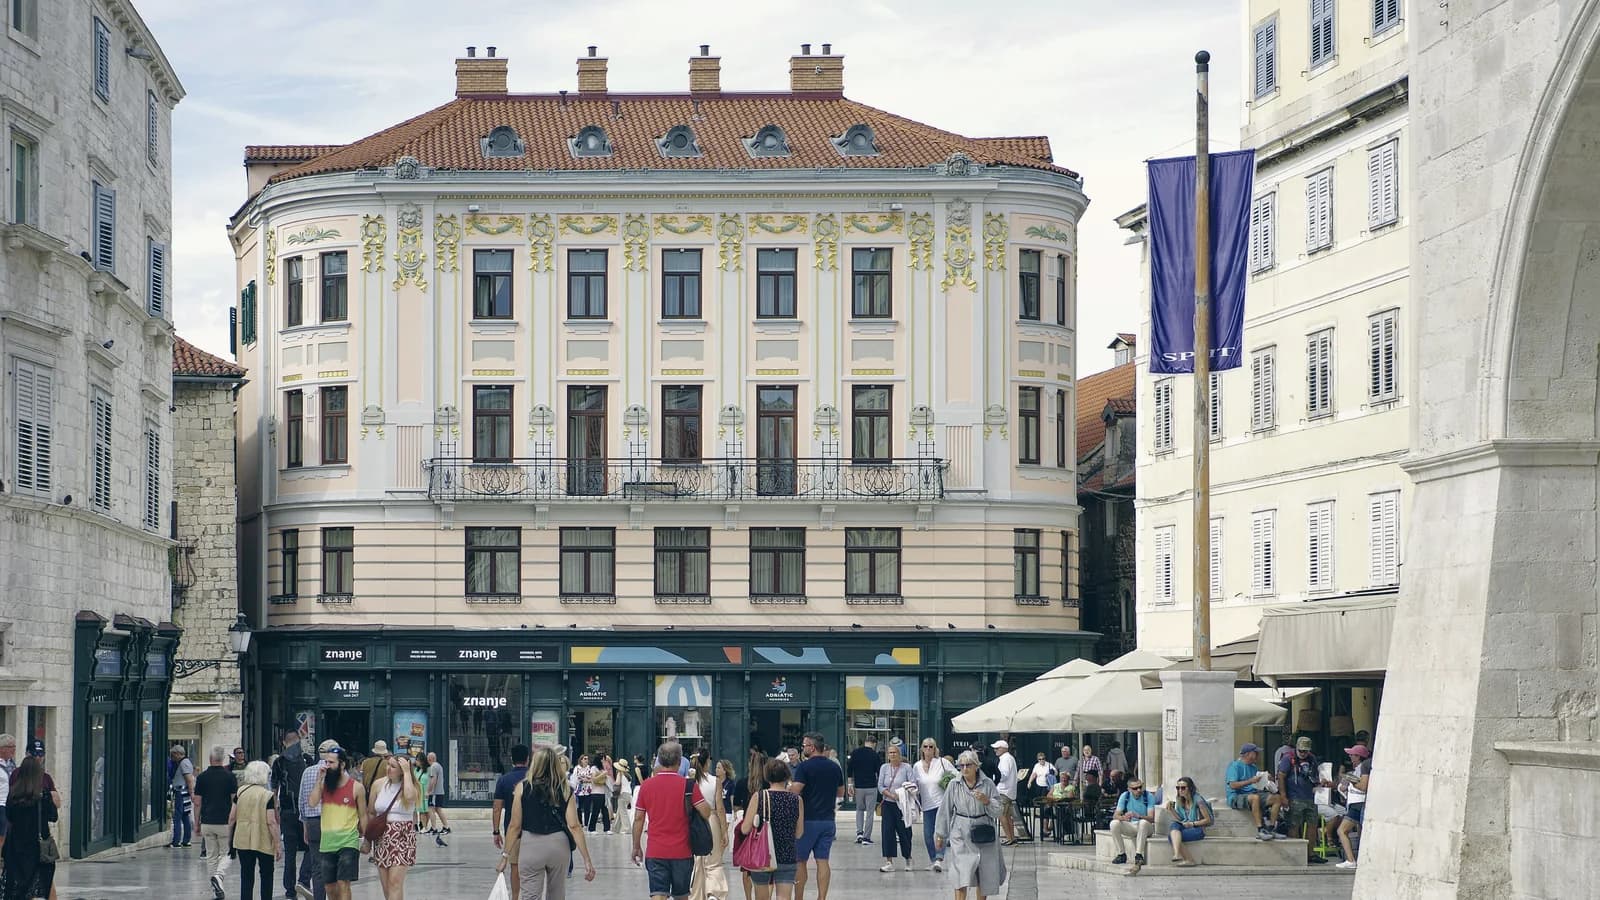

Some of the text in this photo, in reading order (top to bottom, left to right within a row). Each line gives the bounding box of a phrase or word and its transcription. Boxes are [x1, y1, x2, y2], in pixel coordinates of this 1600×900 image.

[1162, 347, 1235, 362] SPIT
[325, 650, 362, 660] znanje
[458, 650, 498, 661] znanje
[333, 680, 360, 690] ATM
[463, 696, 507, 709] znanje
